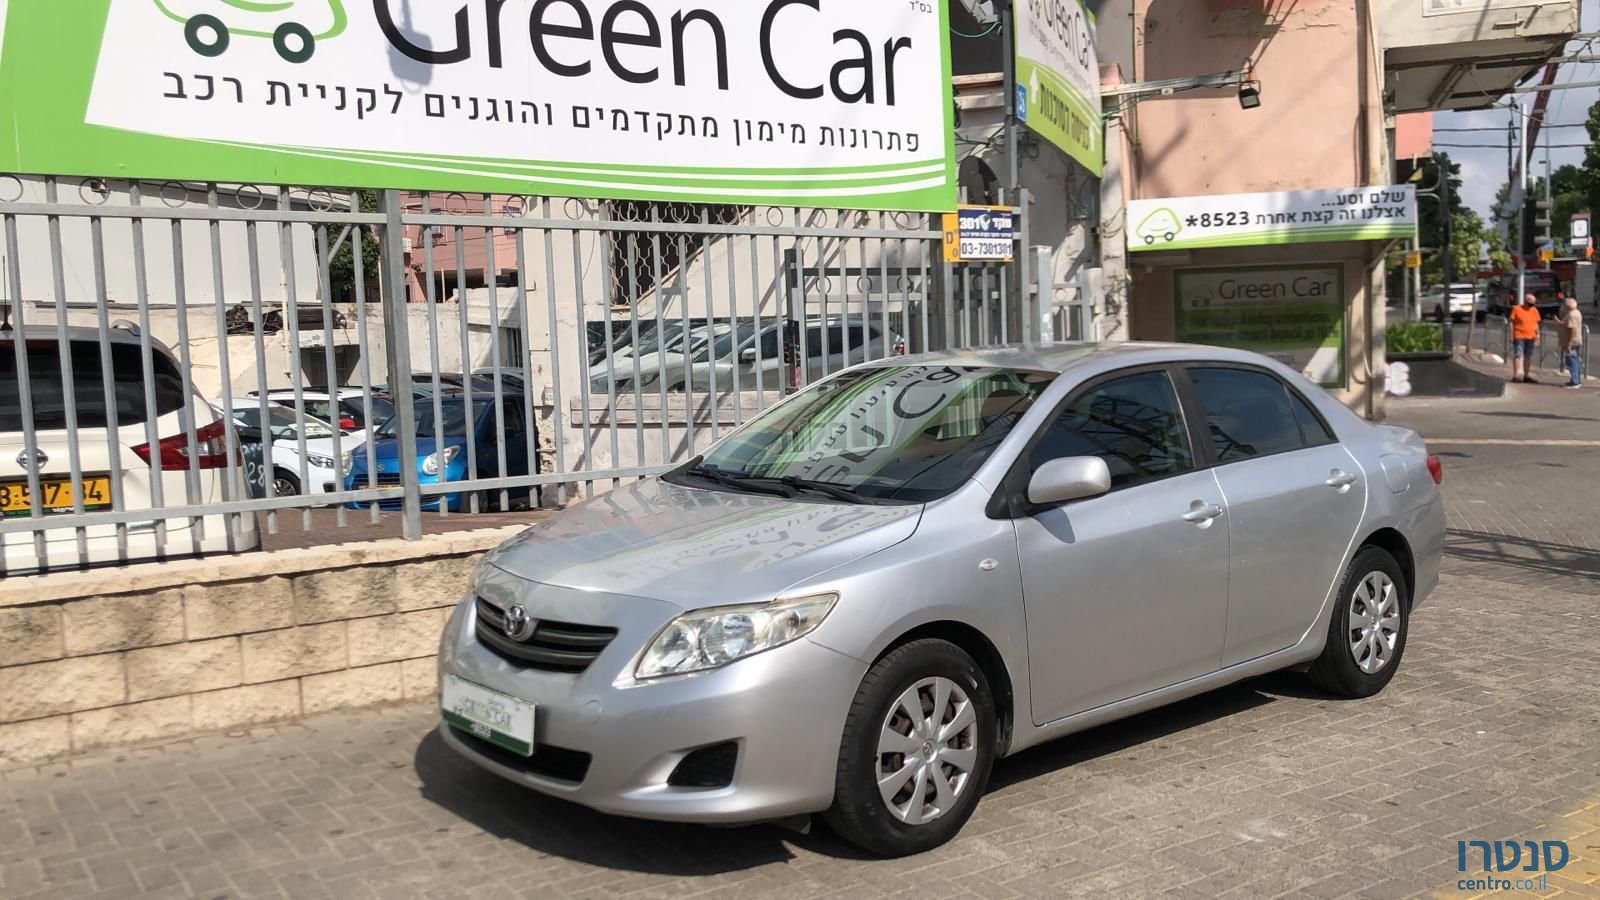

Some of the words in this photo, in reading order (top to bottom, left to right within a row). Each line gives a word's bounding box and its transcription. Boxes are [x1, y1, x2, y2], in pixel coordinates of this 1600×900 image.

[373, 0, 729, 91] Green
[760, 0, 912, 106] Car
[163, 72, 244, 103] רכב
[266, 80, 404, 120] לקניית
[424, 93, 554, 127] והוגנים
[572, 105, 719, 141] מתקדמים
[733, 119, 807, 146] מימון
[819, 126, 920, 152] פתרונות
[1370, 191, 1405, 205] שלם
[959, 217, 980, 230] 301
[1255, 212, 1297, 226] אחרת
[1302, 210, 1334, 225] קצת
[1339, 209, 1356, 220] זה
[1361, 205, 1406, 220] אצלנו
[961, 242, 1012, 255] 03-7301301
[1218, 279, 1286, 300] Green
[1292, 276, 1332, 297] Car
